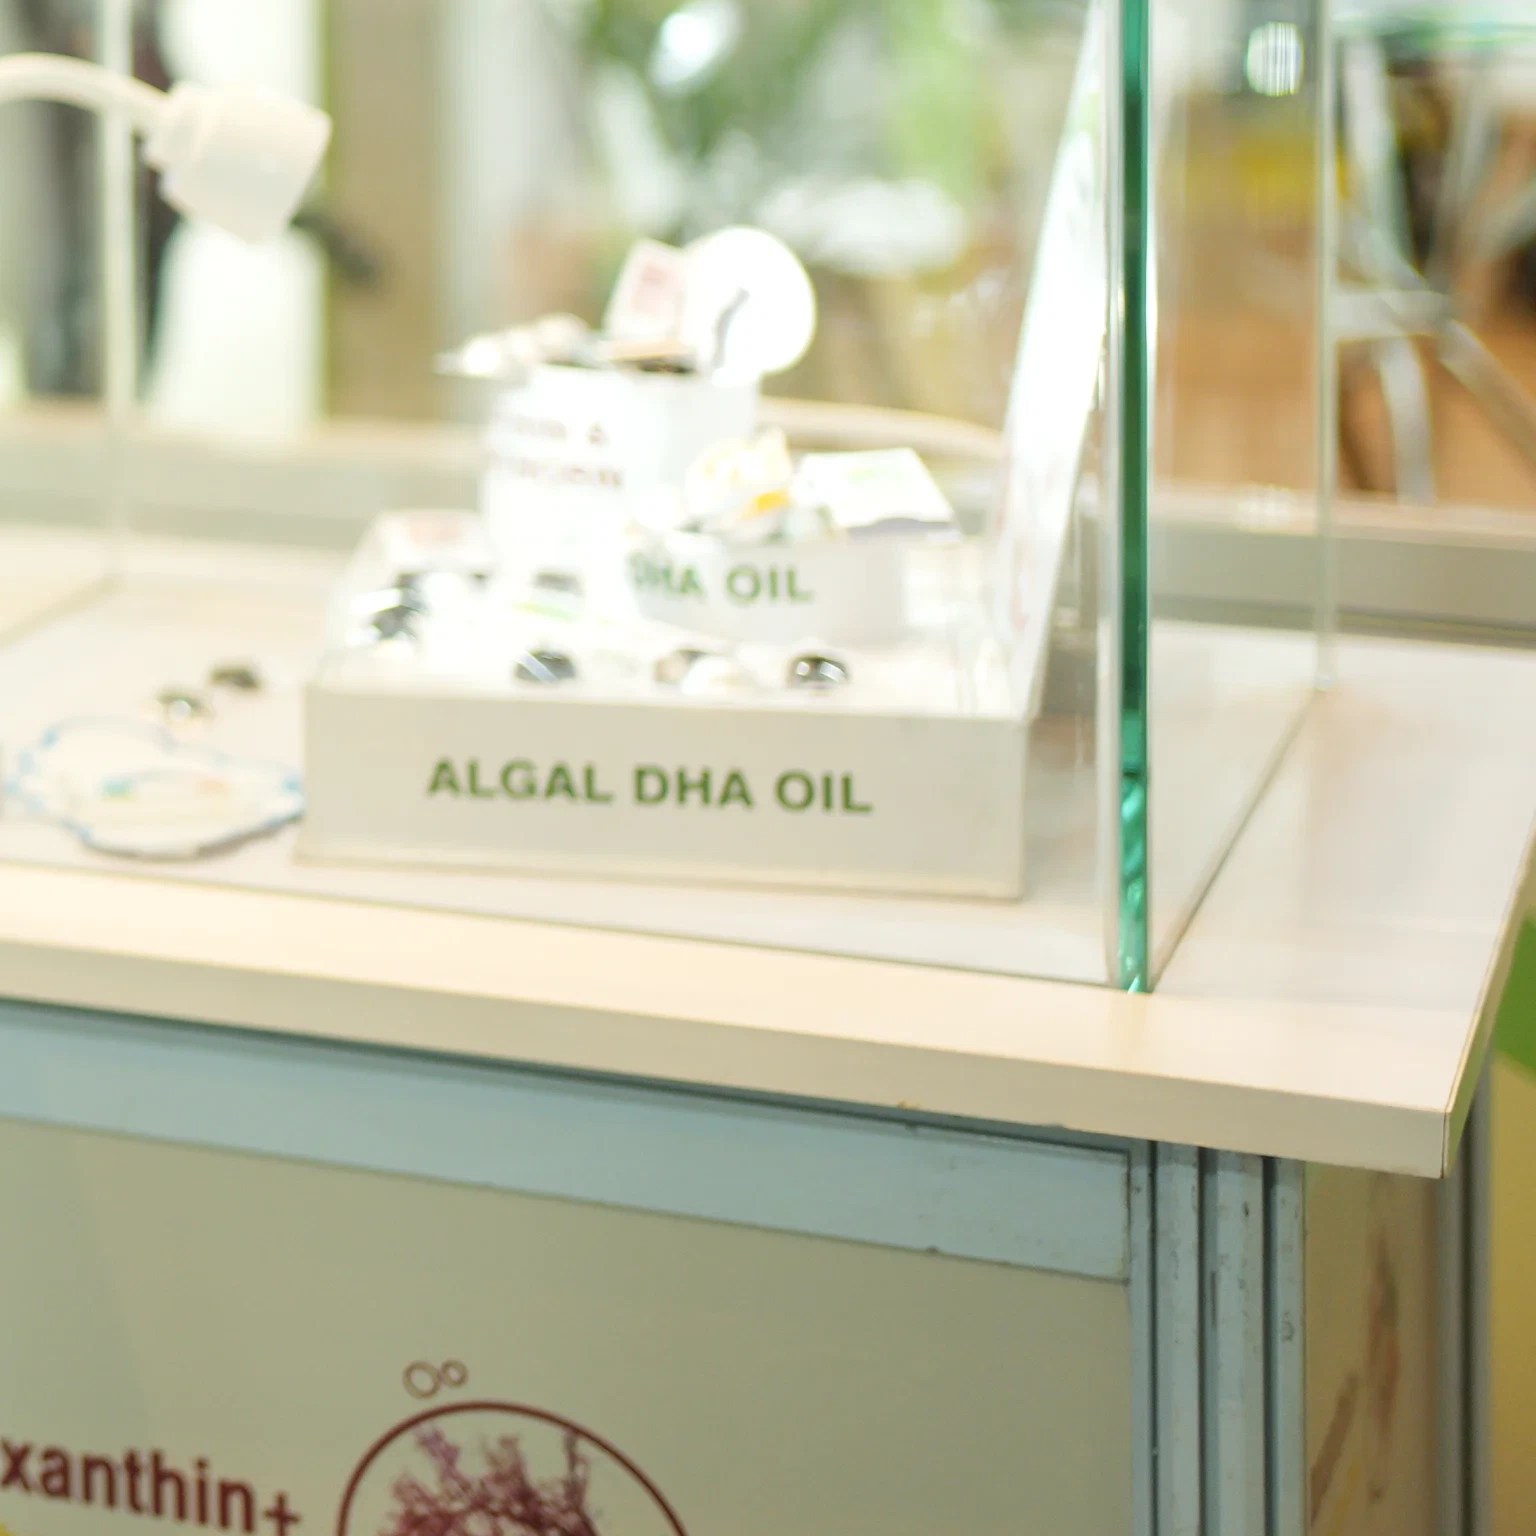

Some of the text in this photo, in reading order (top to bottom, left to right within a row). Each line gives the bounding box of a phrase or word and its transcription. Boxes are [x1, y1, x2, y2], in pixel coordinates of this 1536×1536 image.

[722, 562, 816, 606] OIL
[427, 756, 875, 816] ALGAL DHA OIL
